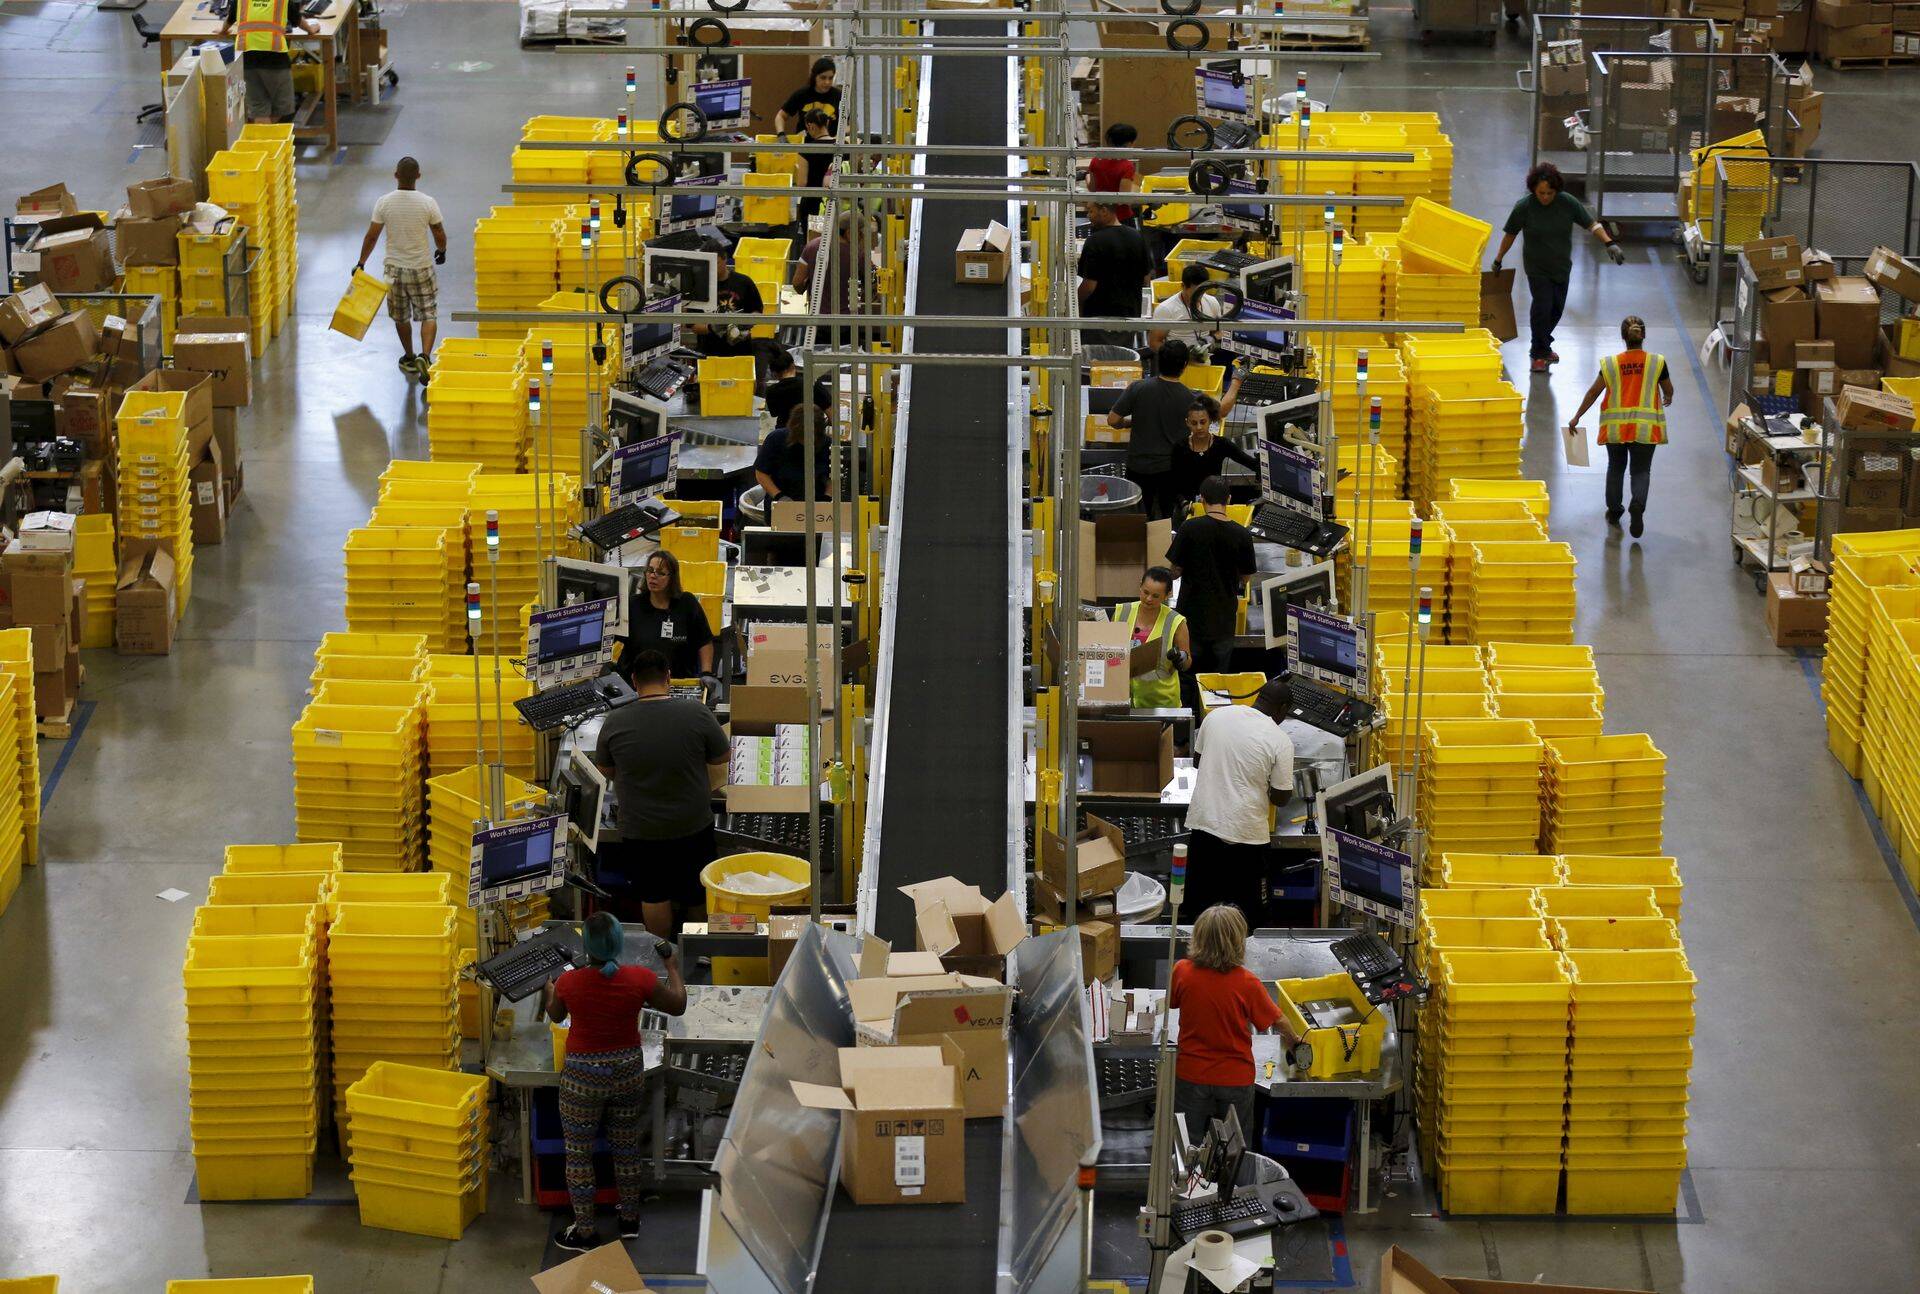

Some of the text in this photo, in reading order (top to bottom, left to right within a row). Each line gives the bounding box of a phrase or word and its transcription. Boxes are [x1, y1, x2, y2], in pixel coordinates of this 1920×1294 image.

[1251, 302, 1269, 312] Station
[627, 446, 640, 454] Work
[640, 441, 656, 451] Station
[1281, 448, 1297, 460] Station
[795, 513, 834, 523] EGA
[546, 602, 601, 620] Work Station 2-d03
[1302, 611, 1317, 620] Work
[1317, 615, 1337, 627] Station
[770, 674, 807, 684] EVG
[489, 820, 550, 839] Work Station 2-d01
[1342, 835, 1359, 847] Work
[1358, 841, 1379, 853] Station
[969, 1016, 1004, 1027] EVGA
